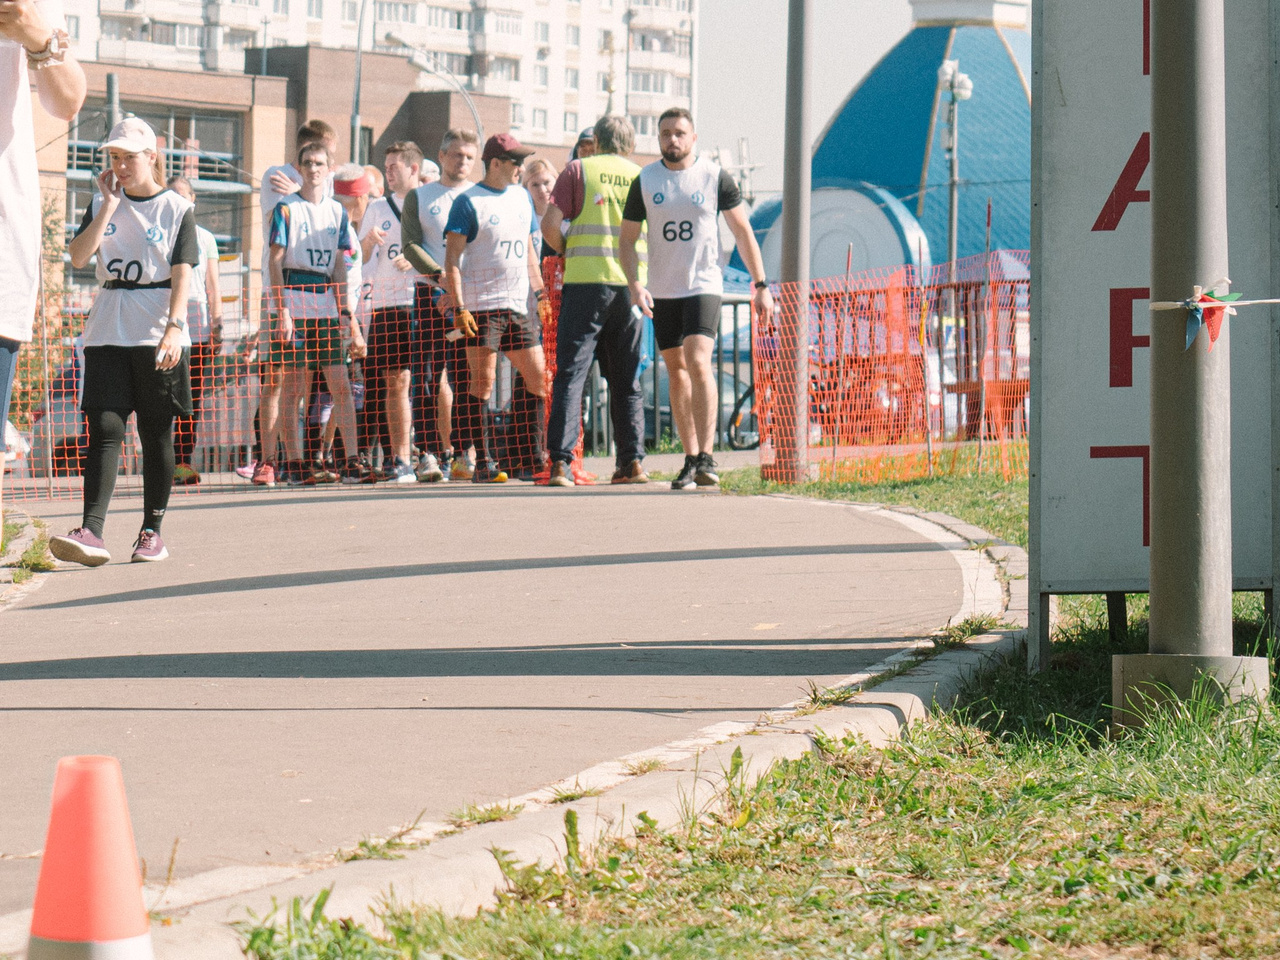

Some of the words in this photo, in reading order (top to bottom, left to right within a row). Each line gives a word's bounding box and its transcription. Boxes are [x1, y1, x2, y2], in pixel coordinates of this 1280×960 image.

[599, 172, 634, 188] СУДЬ
[662, 220, 694, 242] 68
[306, 248, 333, 268] 127
[500, 239, 524, 259] 70
